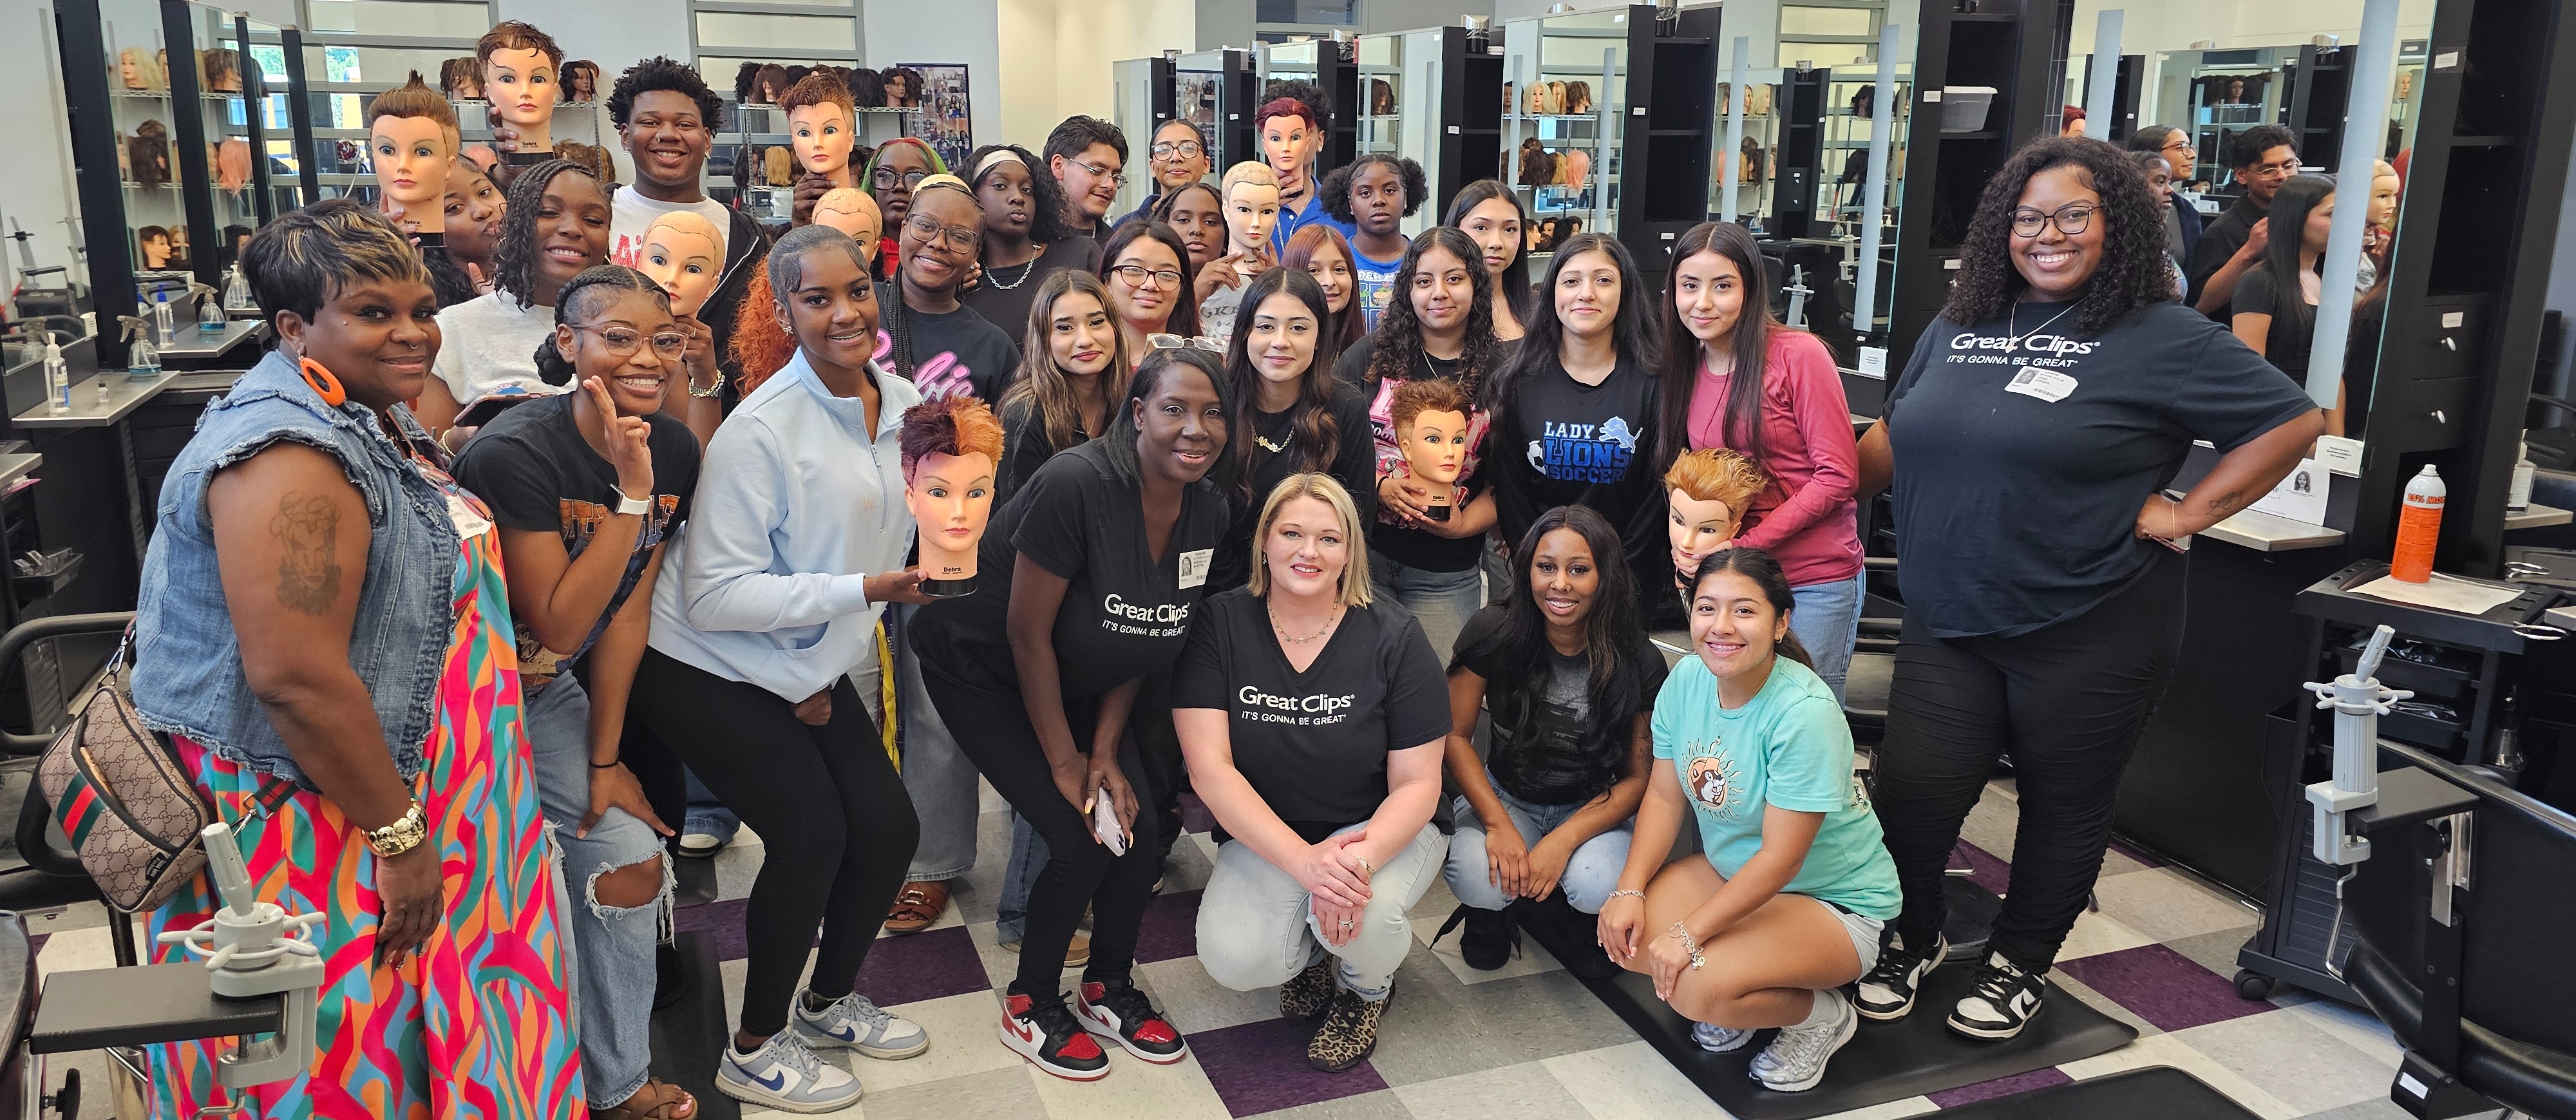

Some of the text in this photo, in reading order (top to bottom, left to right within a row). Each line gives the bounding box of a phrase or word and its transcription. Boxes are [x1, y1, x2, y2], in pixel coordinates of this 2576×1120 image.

[1358, 269, 1383, 280] PER
[1950, 333, 2021, 350] Great
[1946, 355, 1966, 363] IT'S
[1967, 355, 2008, 365] GONNA
[2011, 357, 2030, 366] BE
[1544, 421, 1595, 439] LADY
[1544, 439, 1632, 468] LIONS
[1548, 465, 1624, 484] SOCCER
[2407, 492, 2425, 503] 25%
[1104, 593, 1155, 622] Great
[1102, 619, 1119, 631] IT'S
[1119, 625, 1148, 636] GONNA
[1149, 629, 1160, 637] BE
[1238, 685, 1298, 711] Great
[1242, 710, 1258, 721] IT'S
[1261, 713, 1296, 725] GONNA
